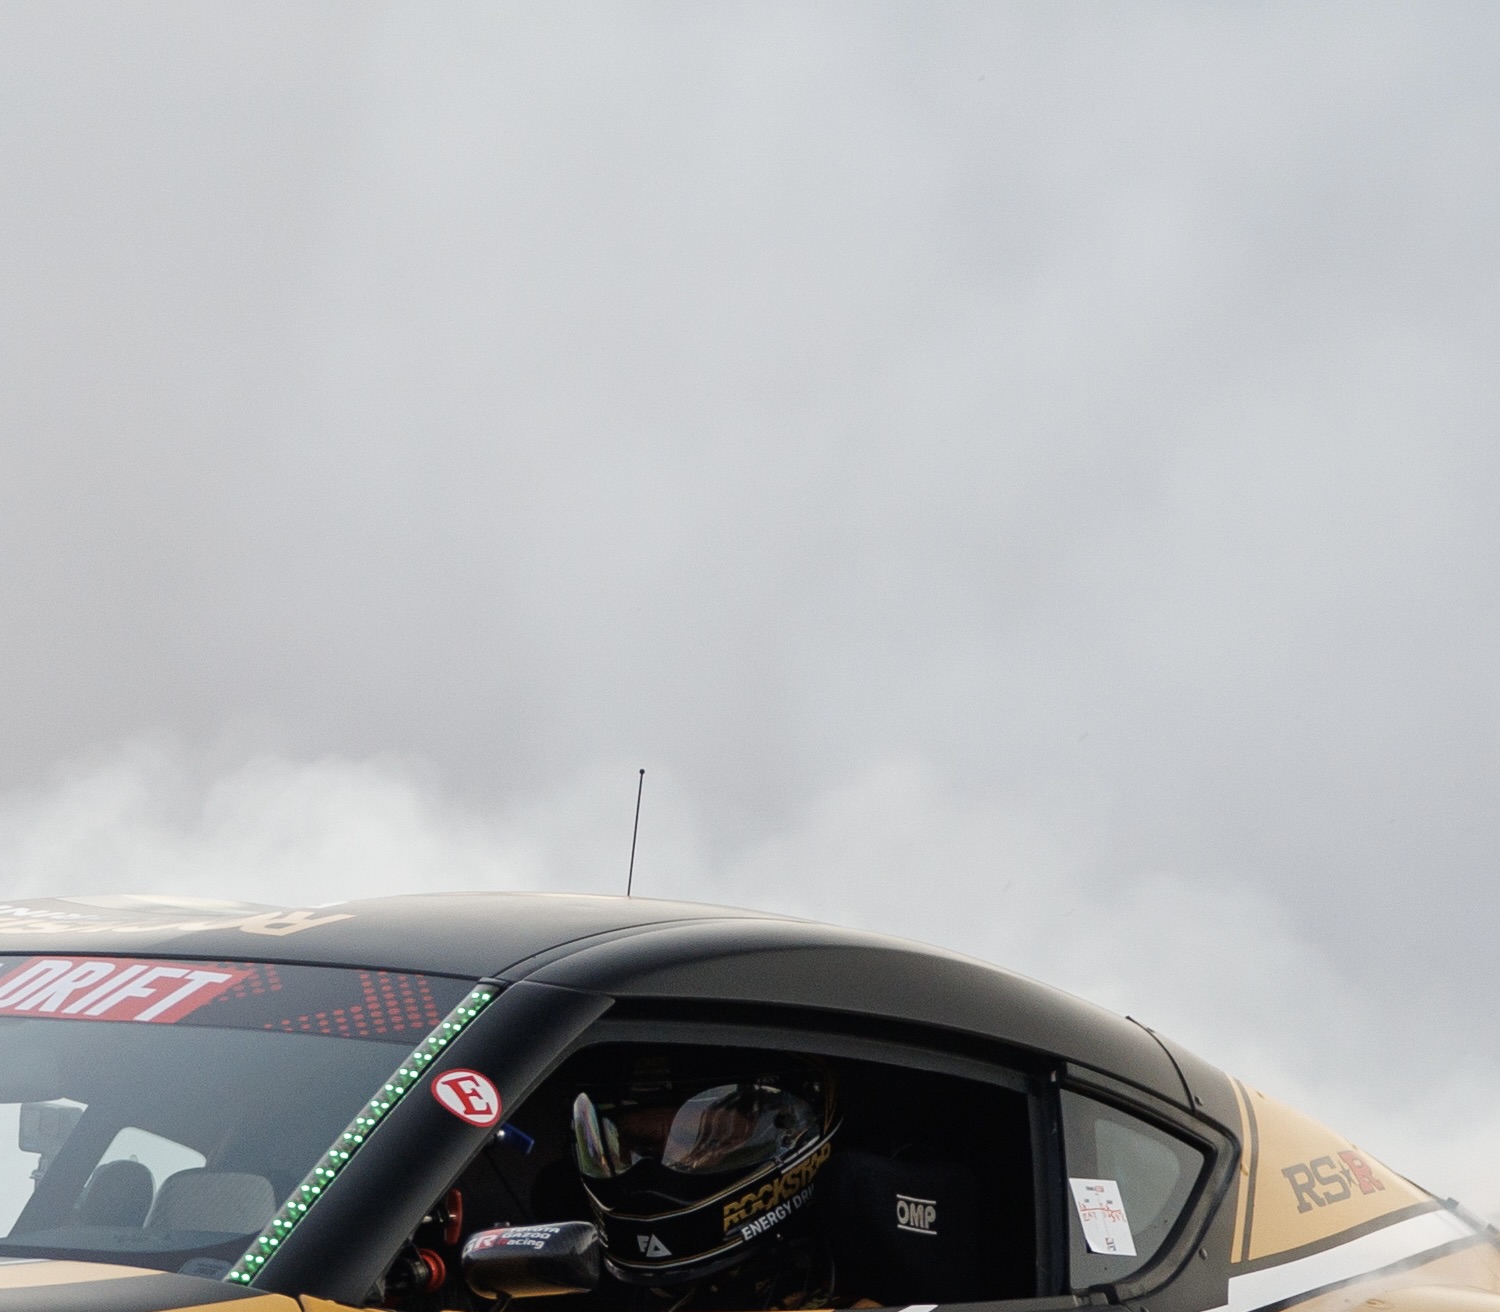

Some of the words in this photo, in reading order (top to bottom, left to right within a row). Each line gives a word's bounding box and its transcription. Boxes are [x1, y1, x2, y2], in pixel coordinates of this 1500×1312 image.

[441, 1075, 493, 1115] E
[741, 1202, 792, 1241] ENERGY
[897, 1200, 937, 1229] OMP
